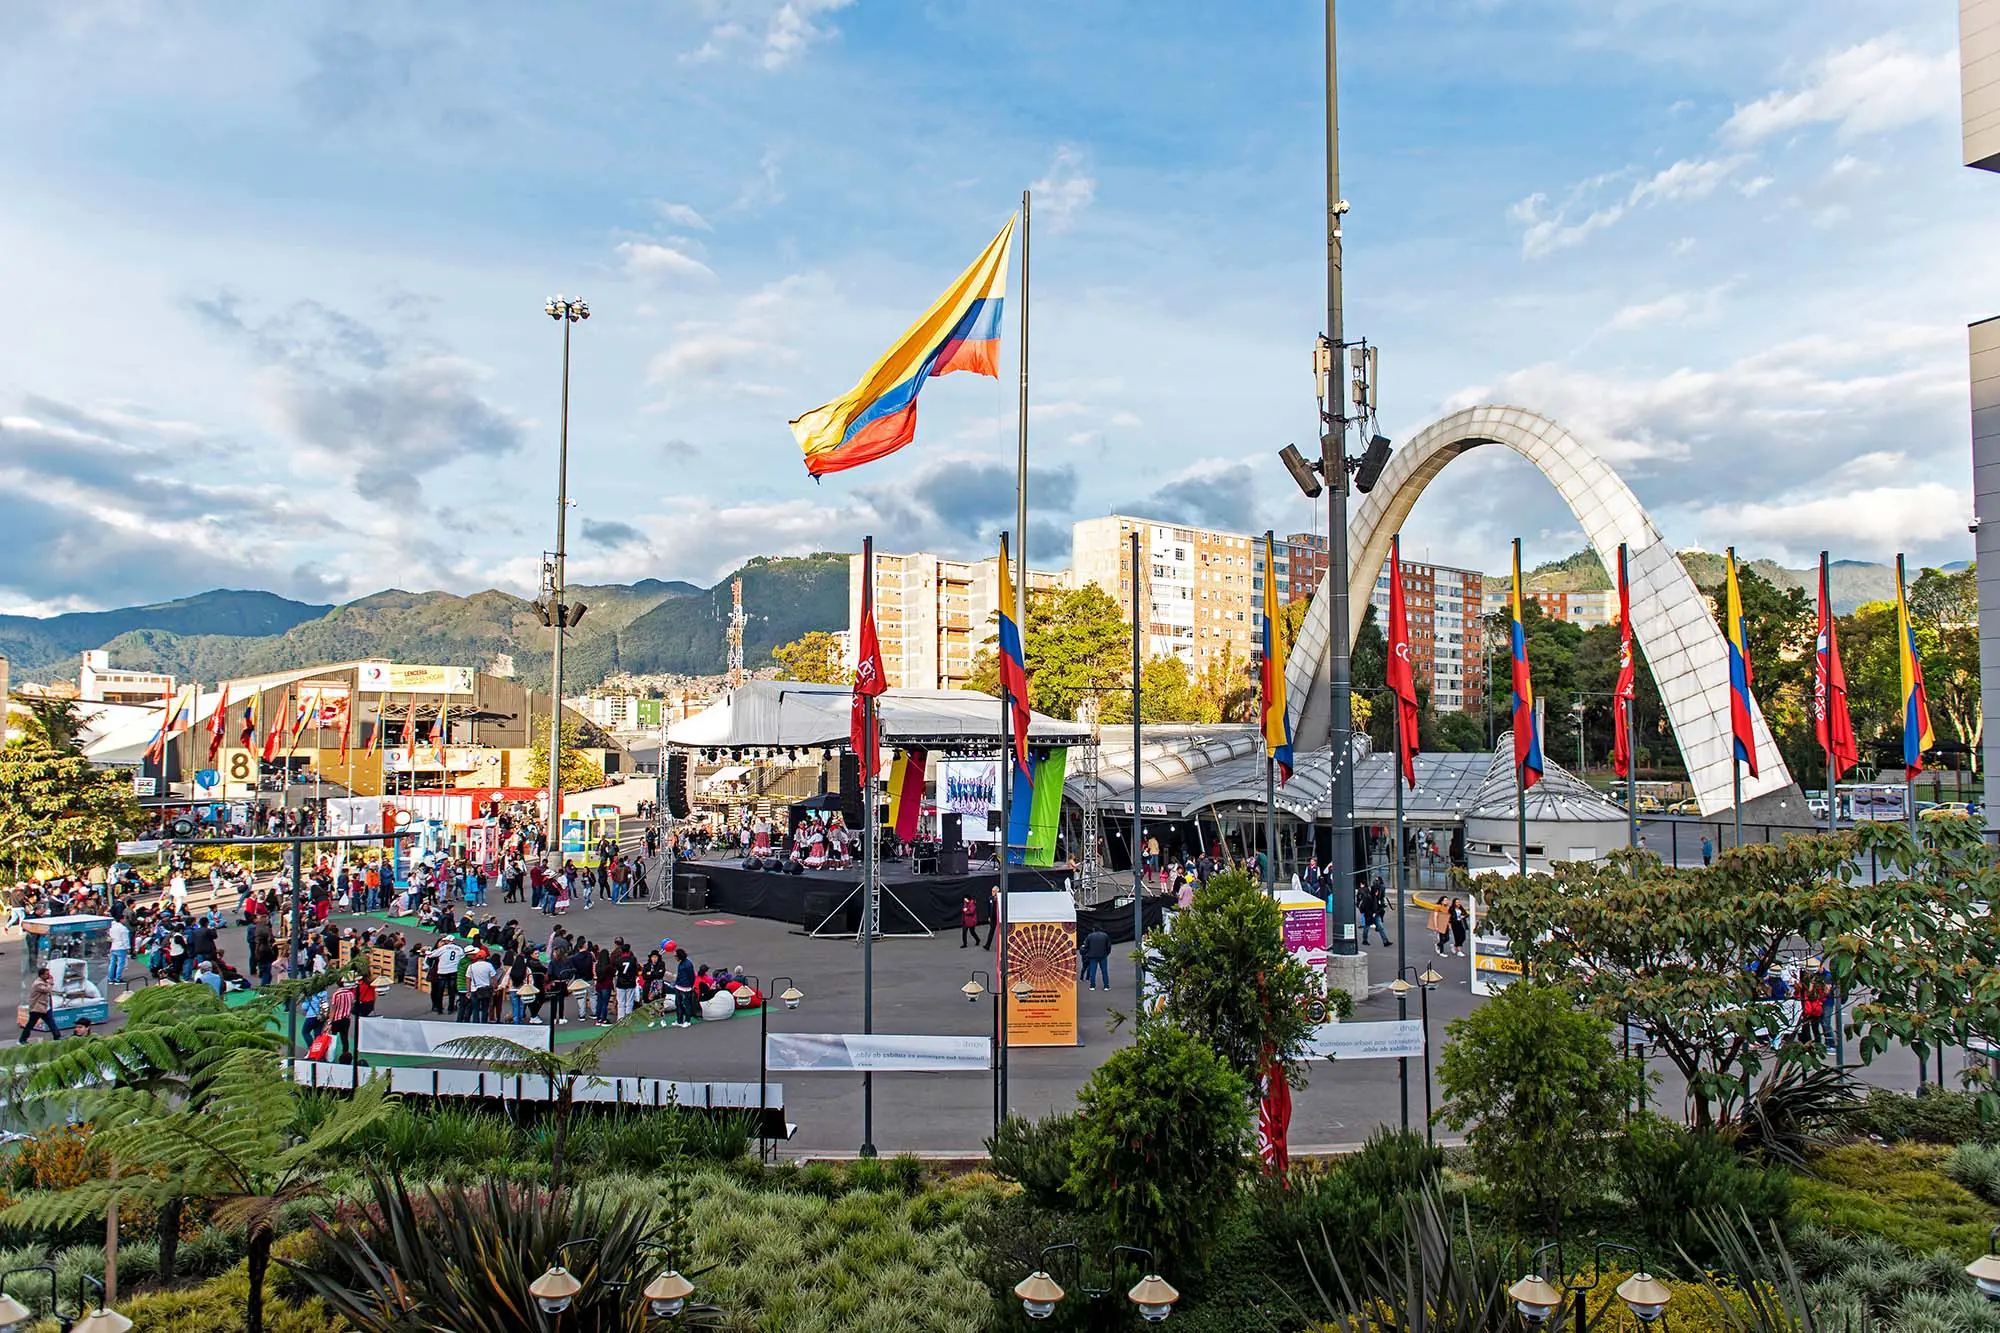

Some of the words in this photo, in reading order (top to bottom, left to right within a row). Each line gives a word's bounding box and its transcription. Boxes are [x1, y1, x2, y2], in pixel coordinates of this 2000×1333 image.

[230, 752, 250, 780] 8
[450, 951, 456, 961] 8
[622, 961, 630, 974] 7
